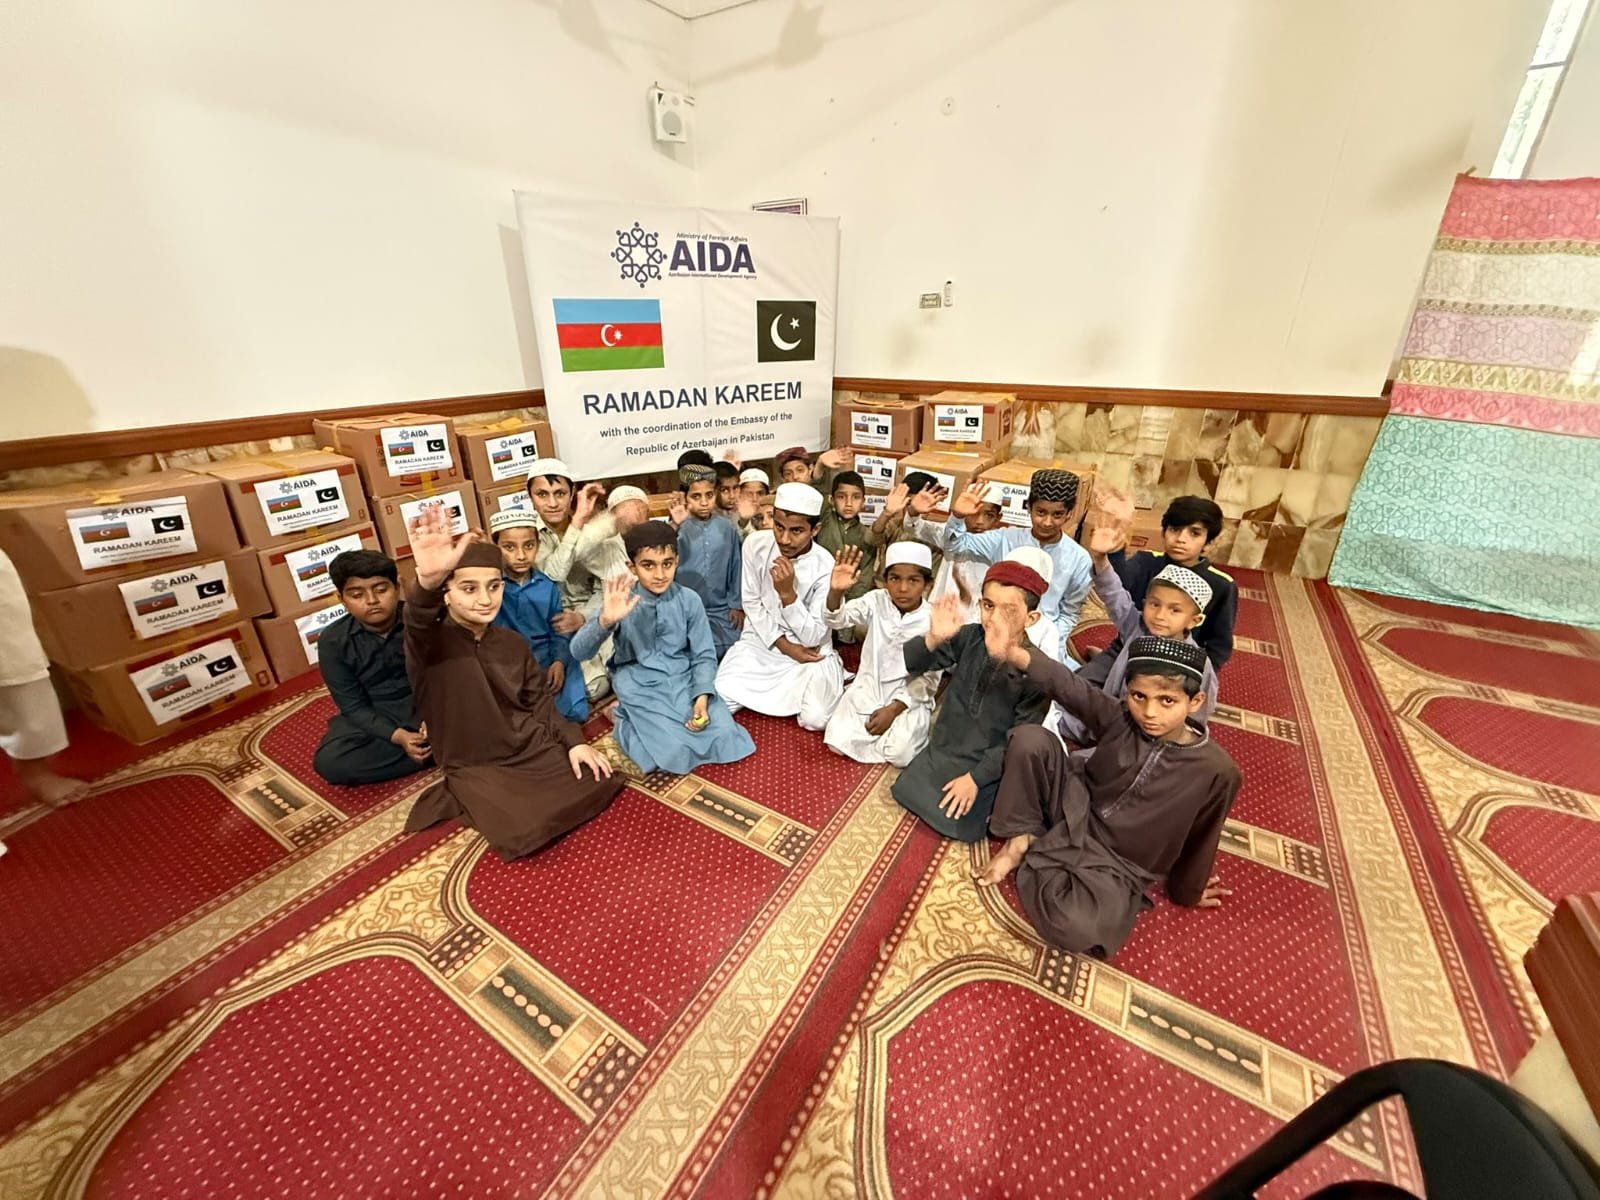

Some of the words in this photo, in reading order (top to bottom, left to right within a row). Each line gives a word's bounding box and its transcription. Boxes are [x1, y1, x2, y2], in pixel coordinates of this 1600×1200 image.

[669, 240, 756, 273] AIDA
[583, 387, 707, 415] RAMADAN
[715, 381, 802, 405] KAREEM
[600, 428, 621, 438] with
[624, 426, 640, 436] the
[643, 421, 700, 433] coordination
[703, 419, 713, 428] of
[715, 418, 728, 427] the
[731, 414, 768, 426] Embassy
[770, 413, 779, 421] of
[780, 412, 792, 421] the
[411, 430, 428, 438] AIDA
[508, 438, 522, 446] AIDA
[626, 440, 668, 456] Republic
[671, 441, 680, 450] of
[682, 437, 728, 449] Azerbaijan
[730, 436, 738, 444] in
[740, 432, 774, 443] Pakistan
[294, 479, 317, 489] AIDA
[1011, 488, 1027, 496] AIDA
[121, 506, 154, 516] AIDA
[277, 510, 311, 522] RAMADAN
[312, 504, 338, 514] KAREEM
[93, 542, 142, 554] RAMADAN
[144, 535, 181, 546] KAREEM
[320, 545, 341, 556] AIDA
[169, 573, 198, 586] AIDA
[146, 608, 189, 624] RAMADAN
[191, 599, 224, 612] KAREEM
[179, 653, 207, 669] AIDA
[162, 688, 203, 708] RAMADAN
[204, 674, 236, 690] KAREEM
